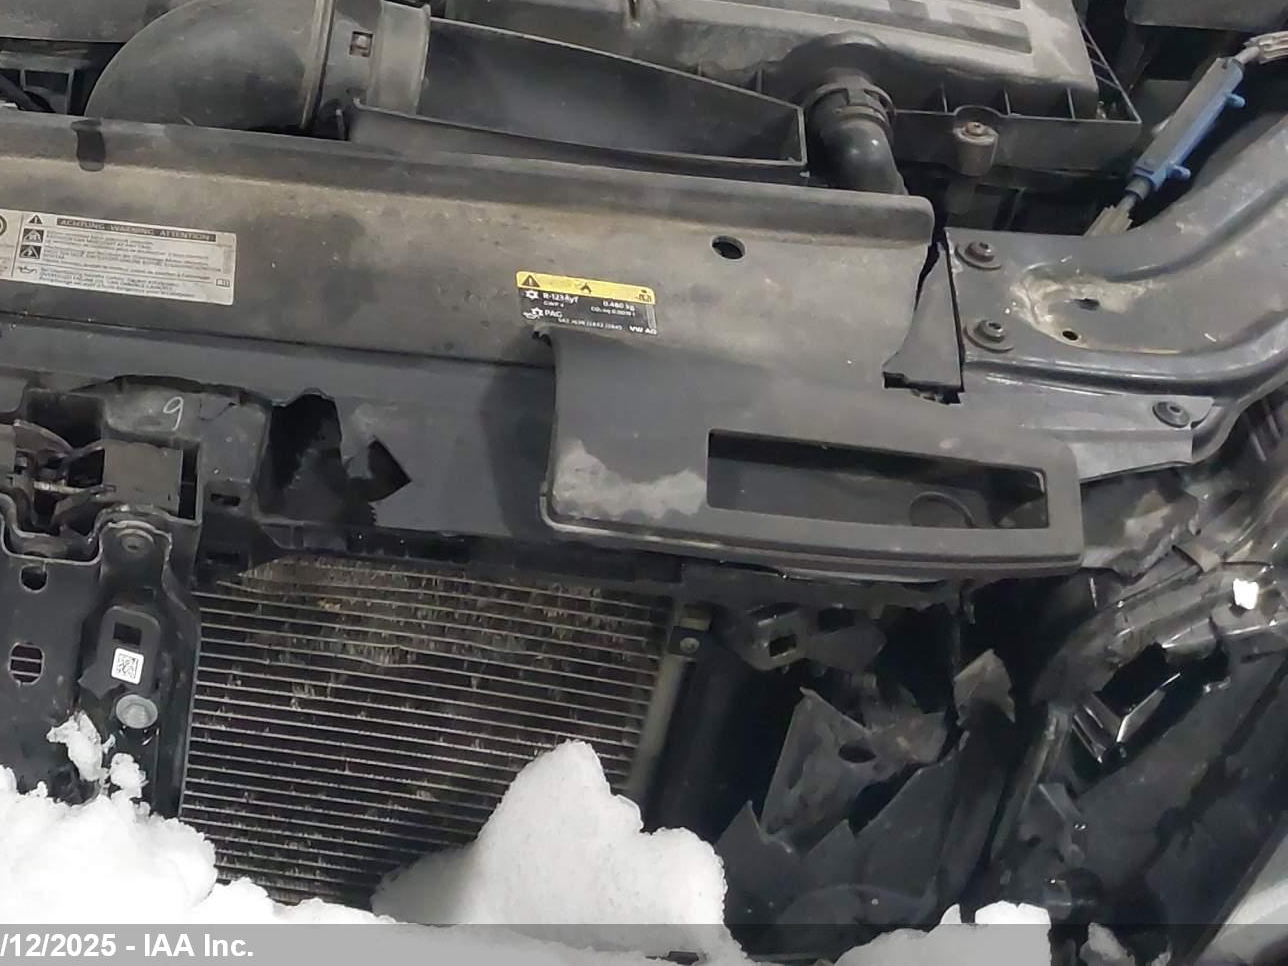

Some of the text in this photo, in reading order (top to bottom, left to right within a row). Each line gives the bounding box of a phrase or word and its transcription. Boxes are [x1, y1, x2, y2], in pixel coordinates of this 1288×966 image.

[59, 219, 105, 230] ACHTUNG
[110, 224, 154, 236] WARNING
[544, 309, 563, 318] PAG
[629, 325, 643, 333] VW
[163, 396, 184, 431] 9
